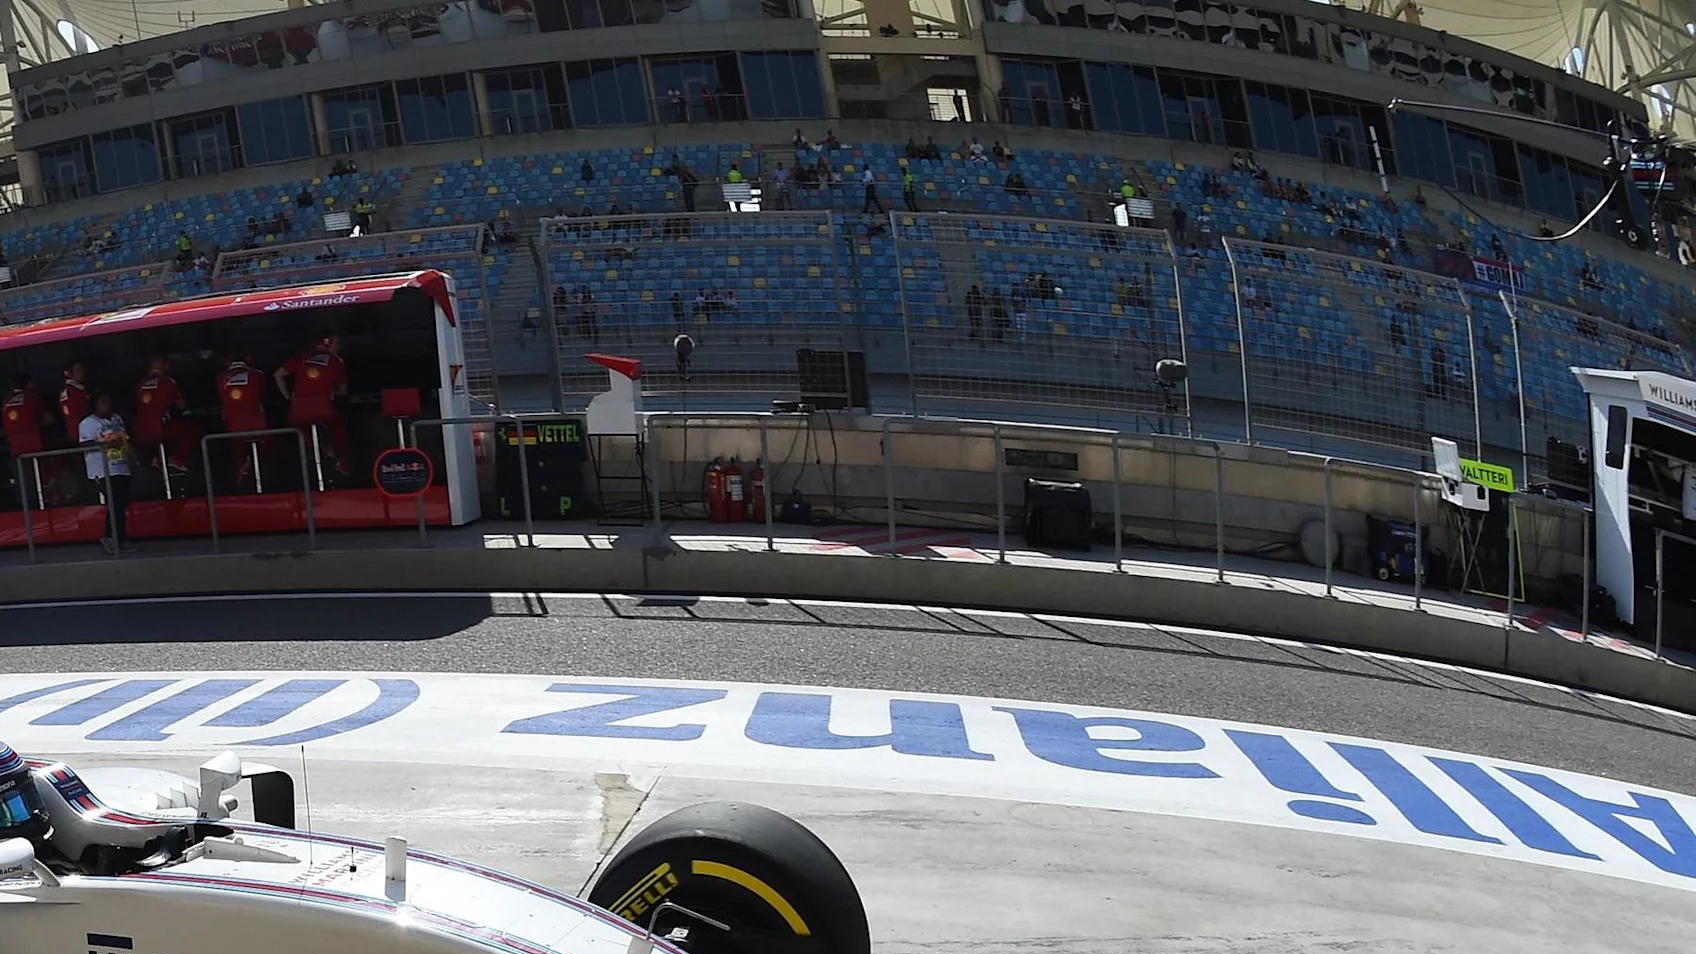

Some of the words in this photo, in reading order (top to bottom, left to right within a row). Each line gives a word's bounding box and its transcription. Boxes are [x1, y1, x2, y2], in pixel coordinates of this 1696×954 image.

[281, 294, 359, 309] Santander
[537, 424, 580, 443] VETTEL
[1460, 465, 1508, 485] VALTTERI
[560, 496, 571, 516] P
[500, 682, 1696, 880] Allianz
[608, 861, 680, 922] RELLI
